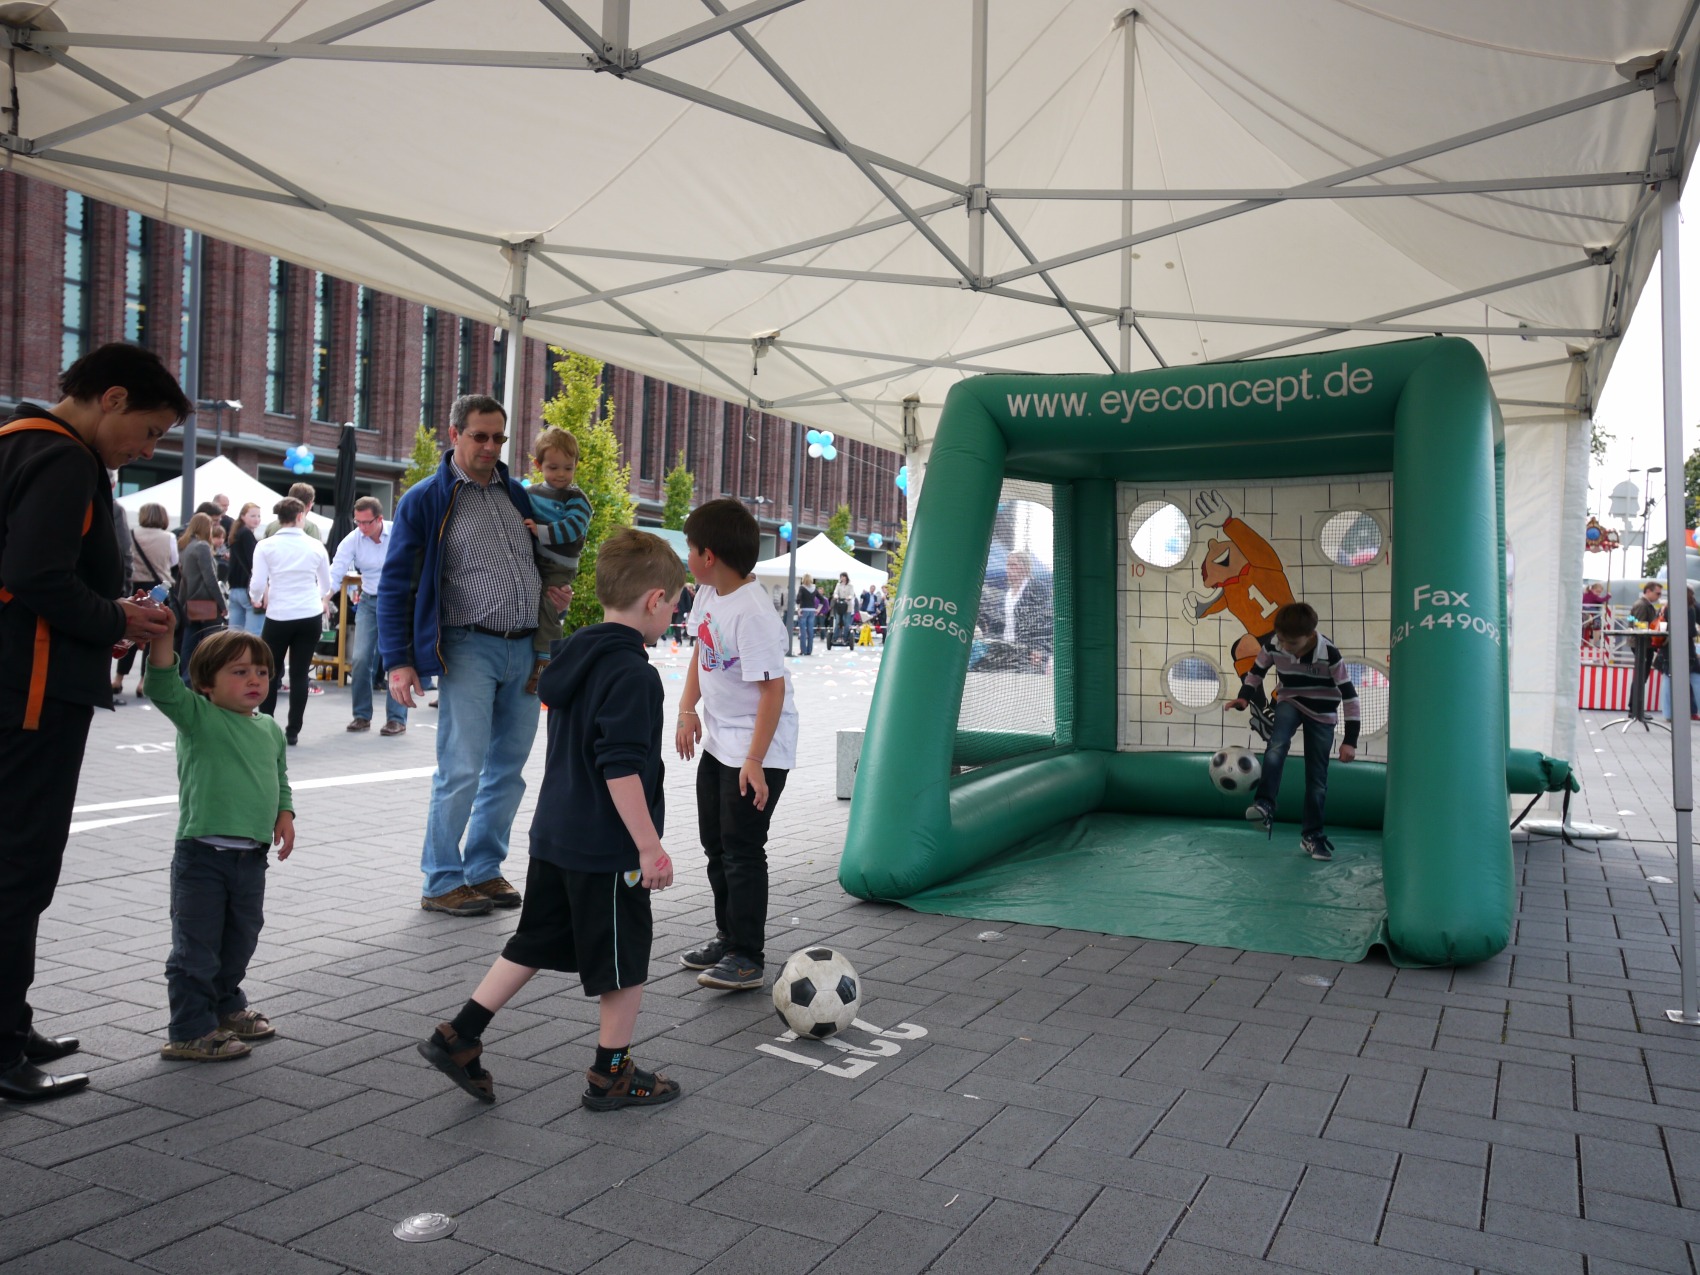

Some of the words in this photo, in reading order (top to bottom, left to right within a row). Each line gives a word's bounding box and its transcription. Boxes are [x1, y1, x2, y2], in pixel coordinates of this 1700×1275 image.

[1131, 562, 1146, 578] 10
[1248, 584, 1279, 619] 1
[1413, 584, 1471, 612] Fax
[1159, 701, 1174, 716] 15
